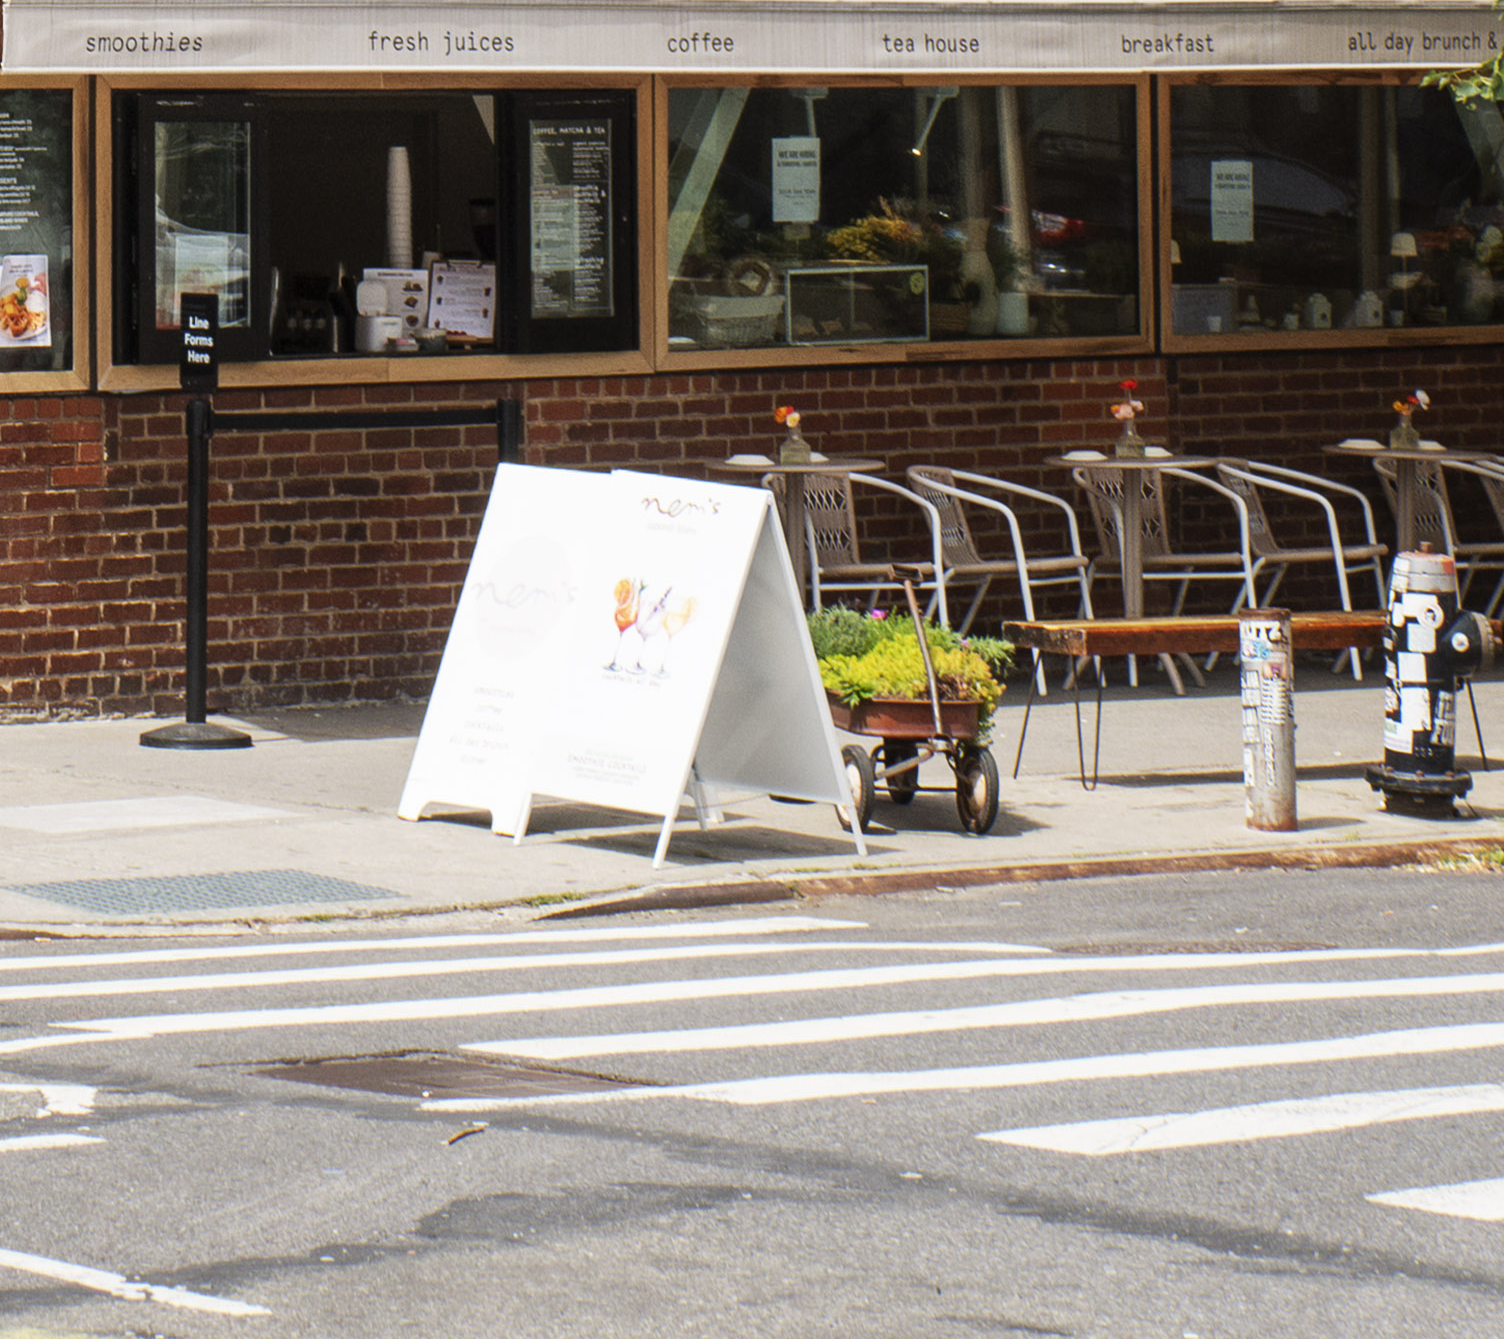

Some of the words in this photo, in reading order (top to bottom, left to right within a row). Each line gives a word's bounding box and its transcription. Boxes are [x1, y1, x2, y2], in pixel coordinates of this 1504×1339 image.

[85, 31, 204, 53] smoothies
[369, 29, 434, 52] fresh
[443, 30, 515, 57] juices
[667, 32, 734, 53] coffee
[882, 33, 915, 53] tea
[923, 32, 980, 53] house
[1121, 31, 1214, 54] breakfast
[1348, 32, 1376, 50] all
[1384, 32, 1414, 55] day
[1423, 32, 1481, 50] brunch
[1487, 32, 1498, 50] &
[189, 315, 209, 330] Line
[184, 332, 214, 347] Forms
[187, 349, 210, 364] Here
[642, 497, 721, 517] nem's
